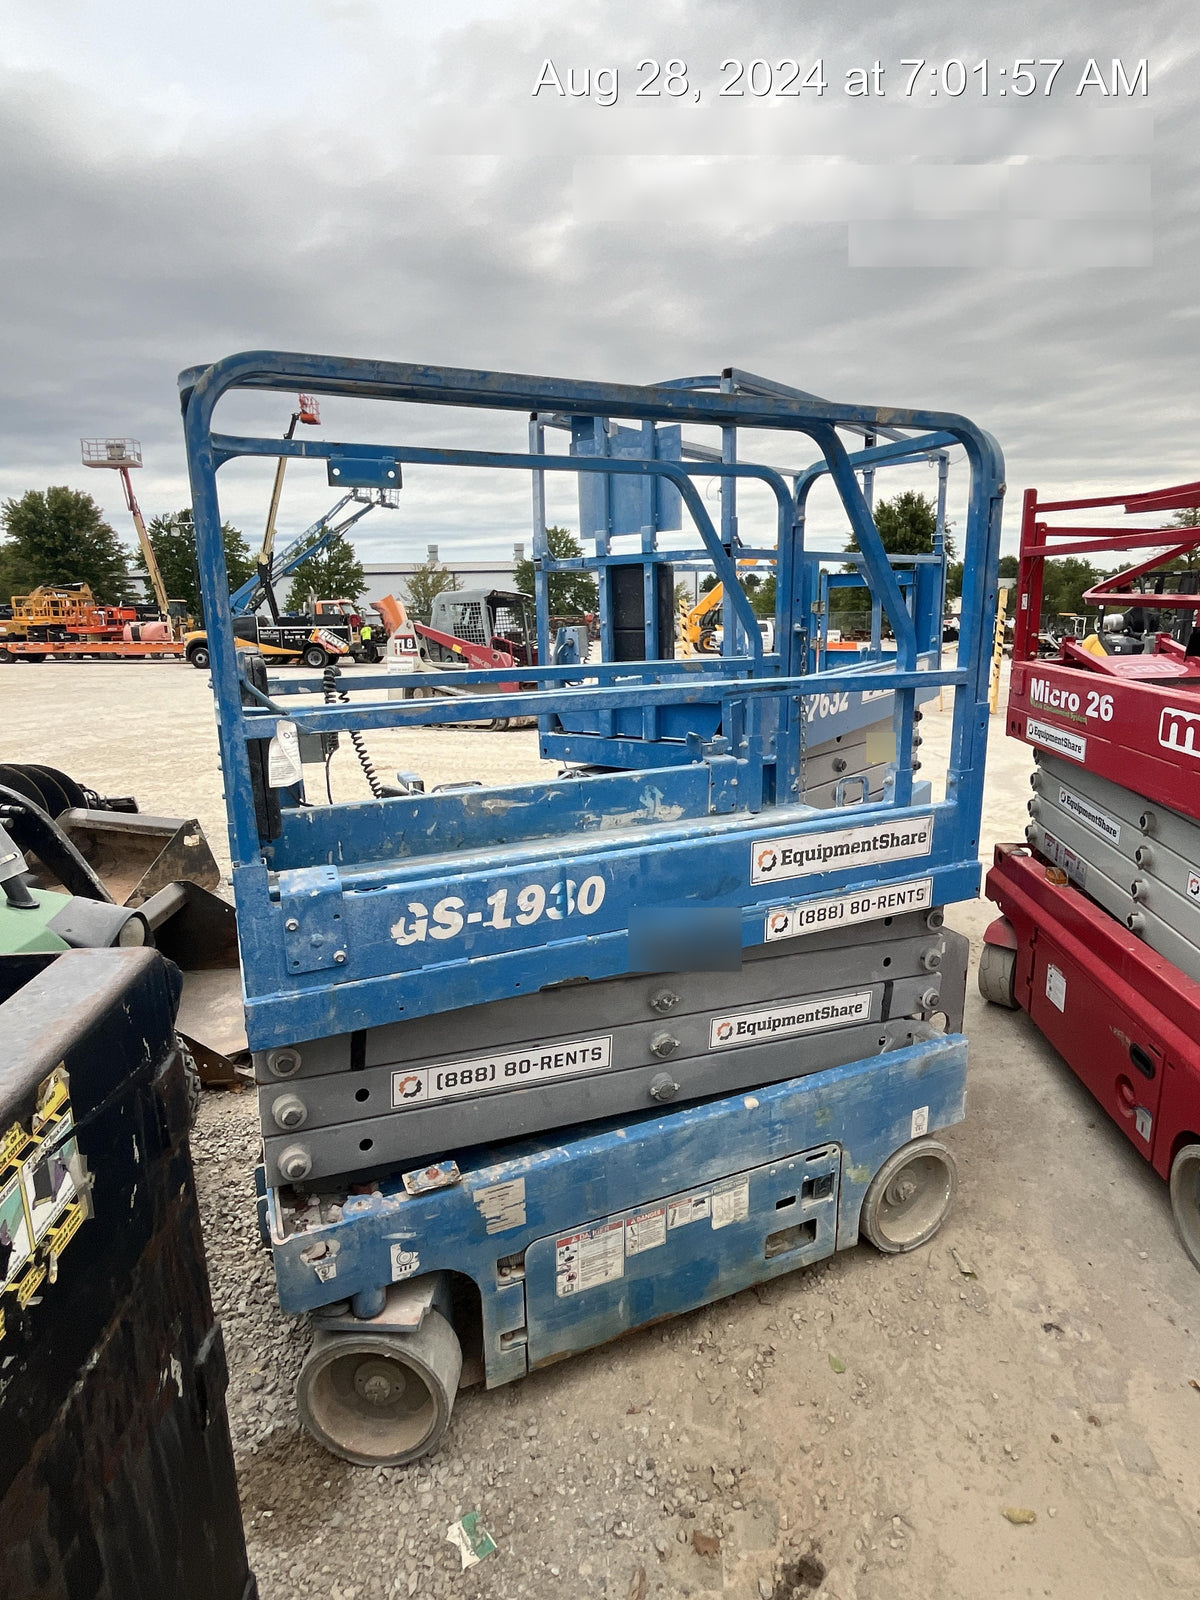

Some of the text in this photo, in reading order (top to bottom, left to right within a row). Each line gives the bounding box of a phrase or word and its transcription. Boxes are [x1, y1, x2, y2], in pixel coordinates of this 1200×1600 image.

[1031, 678, 1113, 722] Micro 26
[1034, 726, 1082, 753] EquipmentShare
[1066, 795, 1118, 838] EquipmentShare
[780, 832, 927, 867] EquipmentShare
[390, 876, 606, 945] GS-1930
[799, 888, 925, 927] (888) 80-RENTS
[736, 1003, 863, 1036] EquipmentShare
[436, 1047, 602, 1090] (888) 80-RENTS
